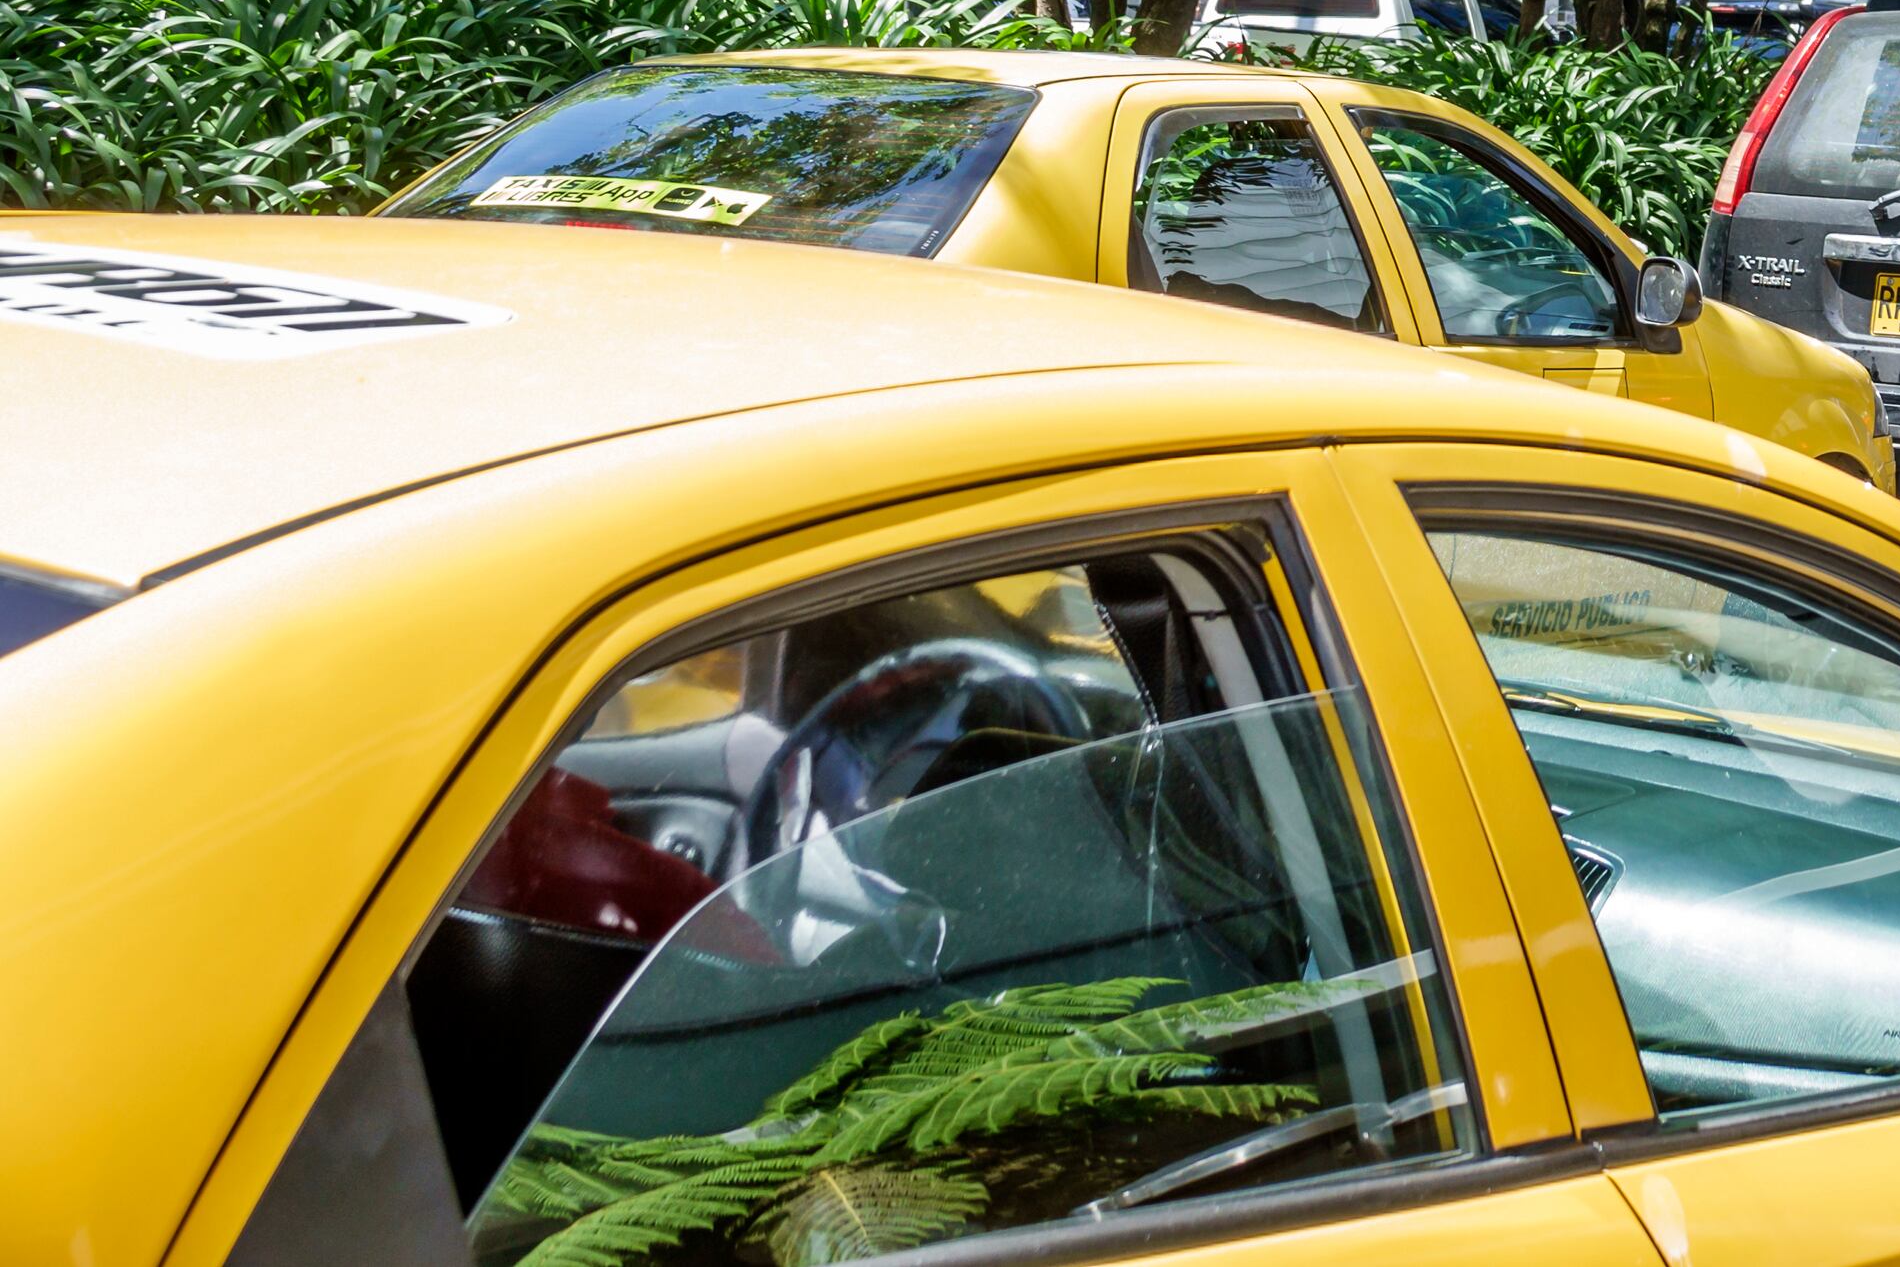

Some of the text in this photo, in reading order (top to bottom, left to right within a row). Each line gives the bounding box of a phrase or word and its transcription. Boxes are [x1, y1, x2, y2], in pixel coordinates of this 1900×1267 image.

[506, 191, 595, 203] LIBRES
[599, 185, 655, 204] App
[1738, 255, 1805, 274] X-TRAIL
[1751, 273, 1792, 287] Classic
[1490, 589, 1650, 637] SERVICIO PUBLICO
